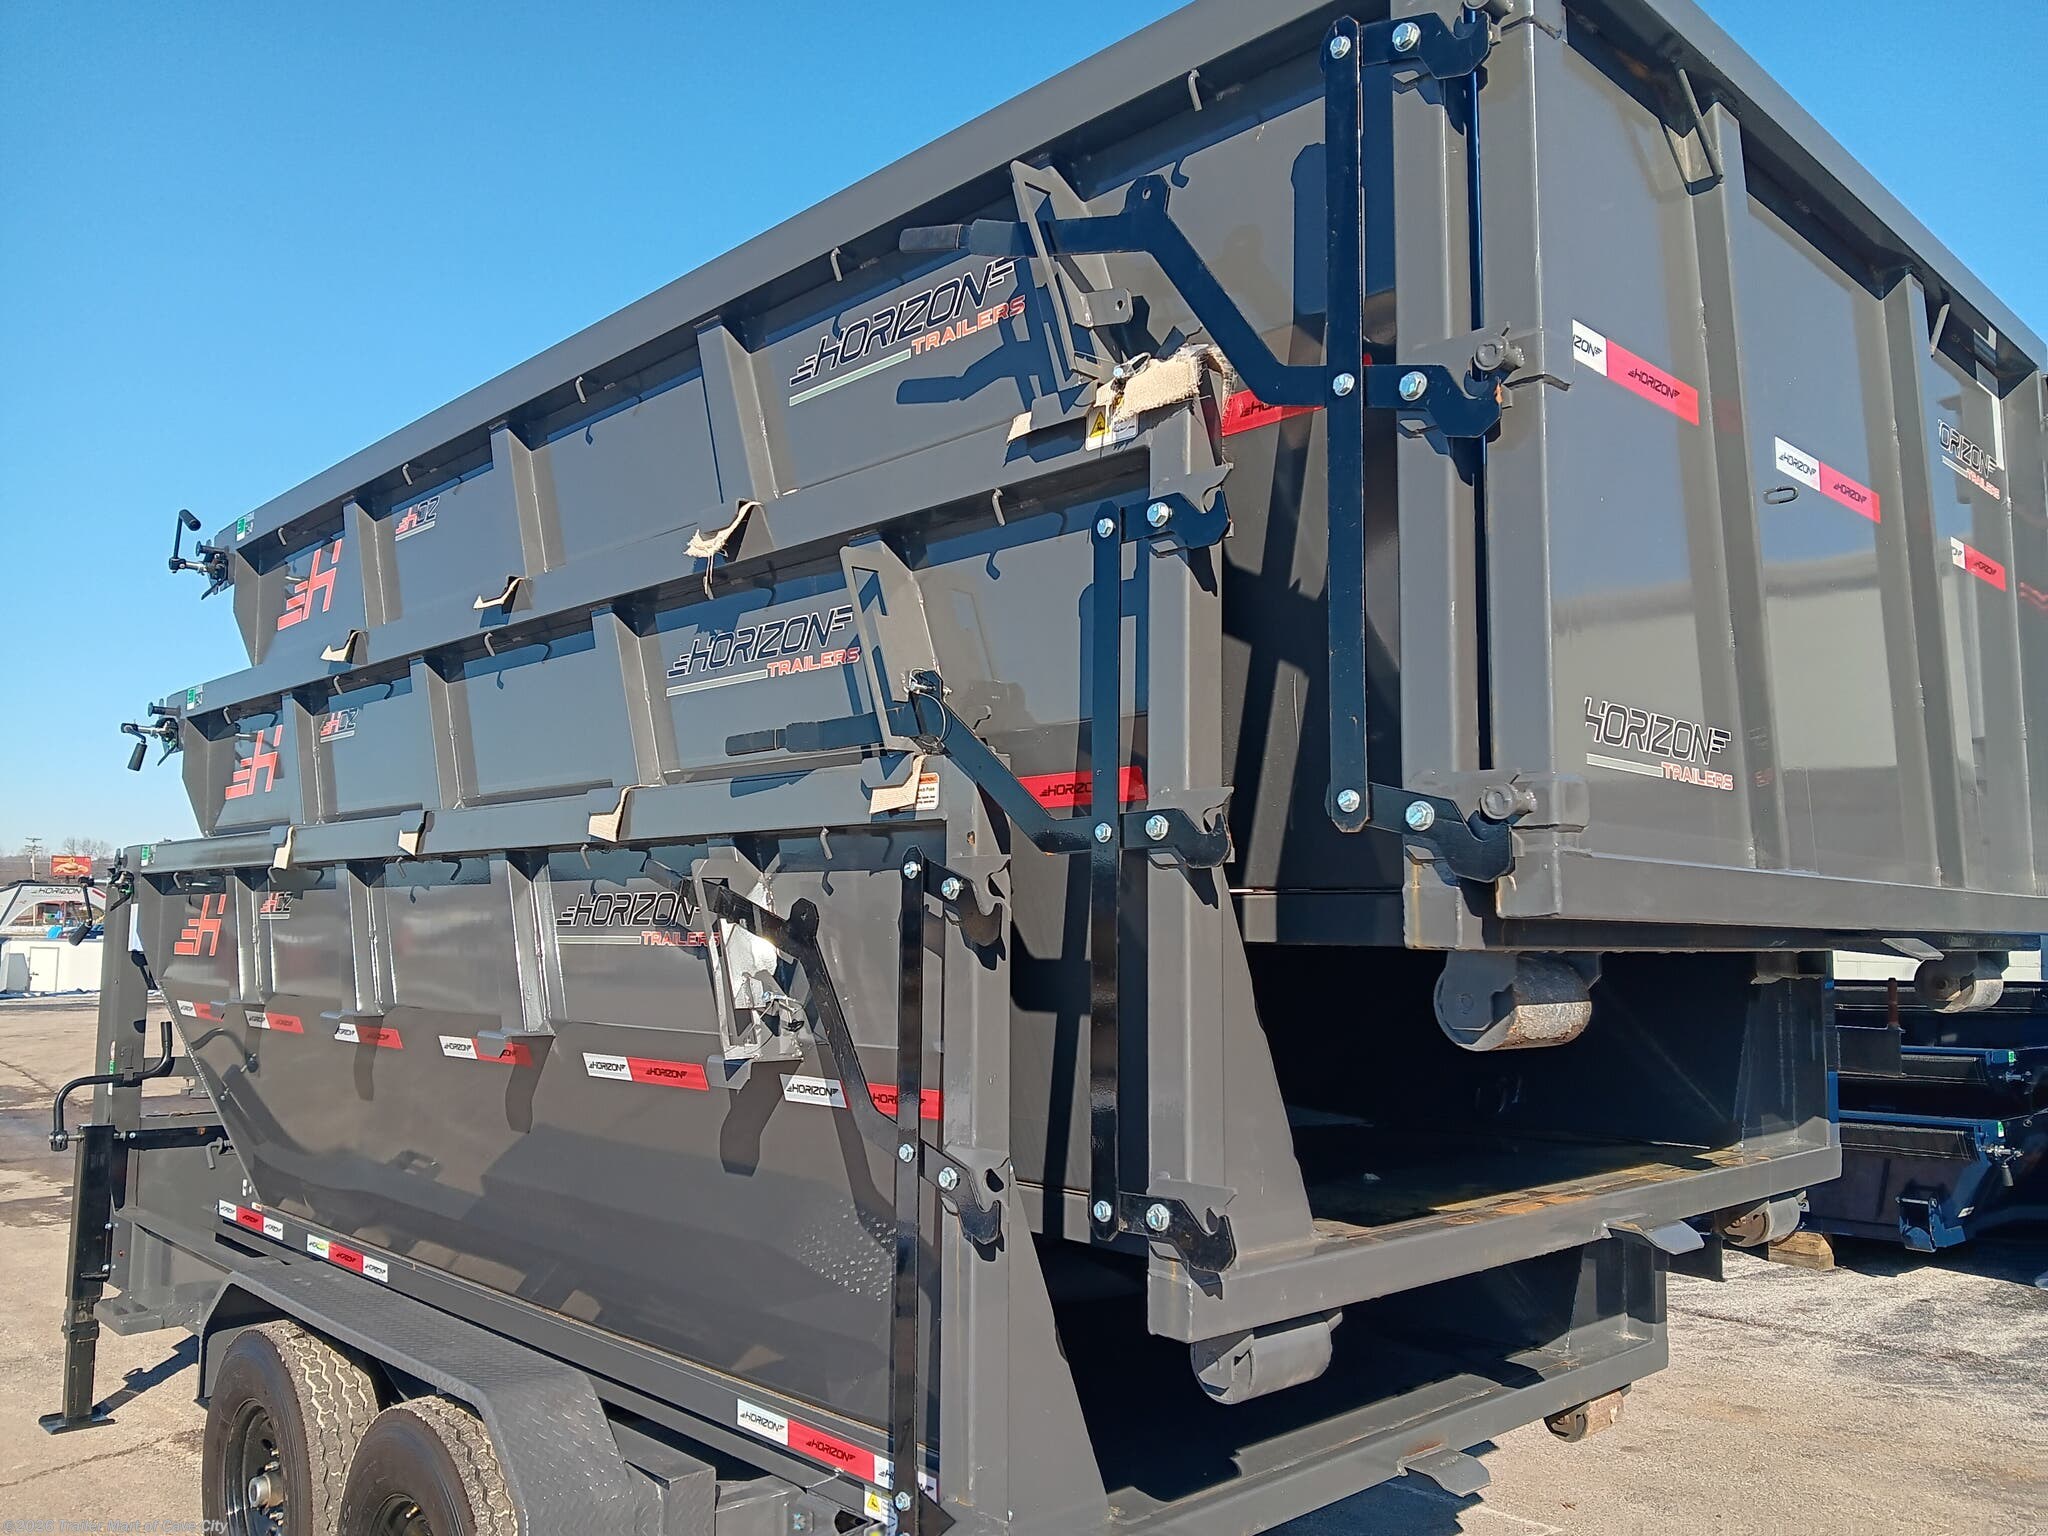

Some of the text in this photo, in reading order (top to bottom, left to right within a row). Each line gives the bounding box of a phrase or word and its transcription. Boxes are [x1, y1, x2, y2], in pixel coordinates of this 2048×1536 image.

[802, 259, 1002, 380] HORIZON
[912, 295, 1026, 355] TRAILERS
[1630, 368, 1678, 398] HORIZON
[1780, 452, 1815, 475] HORIZON
[1938, 418, 1991, 479] ORIZON
[677, 607, 845, 676] HORIZON
[767, 646, 861, 678] TRAILERS
[1585, 697, 1722, 765] HORIZON
[1044, 782, 1092, 796] HORIZO
[1661, 761, 1734, 791] TRAILERS
[566, 892, 696, 926] HORIZON
[590, 1061, 625, 1071] HORIZON
[647, 1068, 686, 1079] HORIZON
[789, 1084, 836, 1096] HORIZON
[742, 1411, 783, 1431] HORIZON
[808, 1440, 854, 1461] HORIZON
